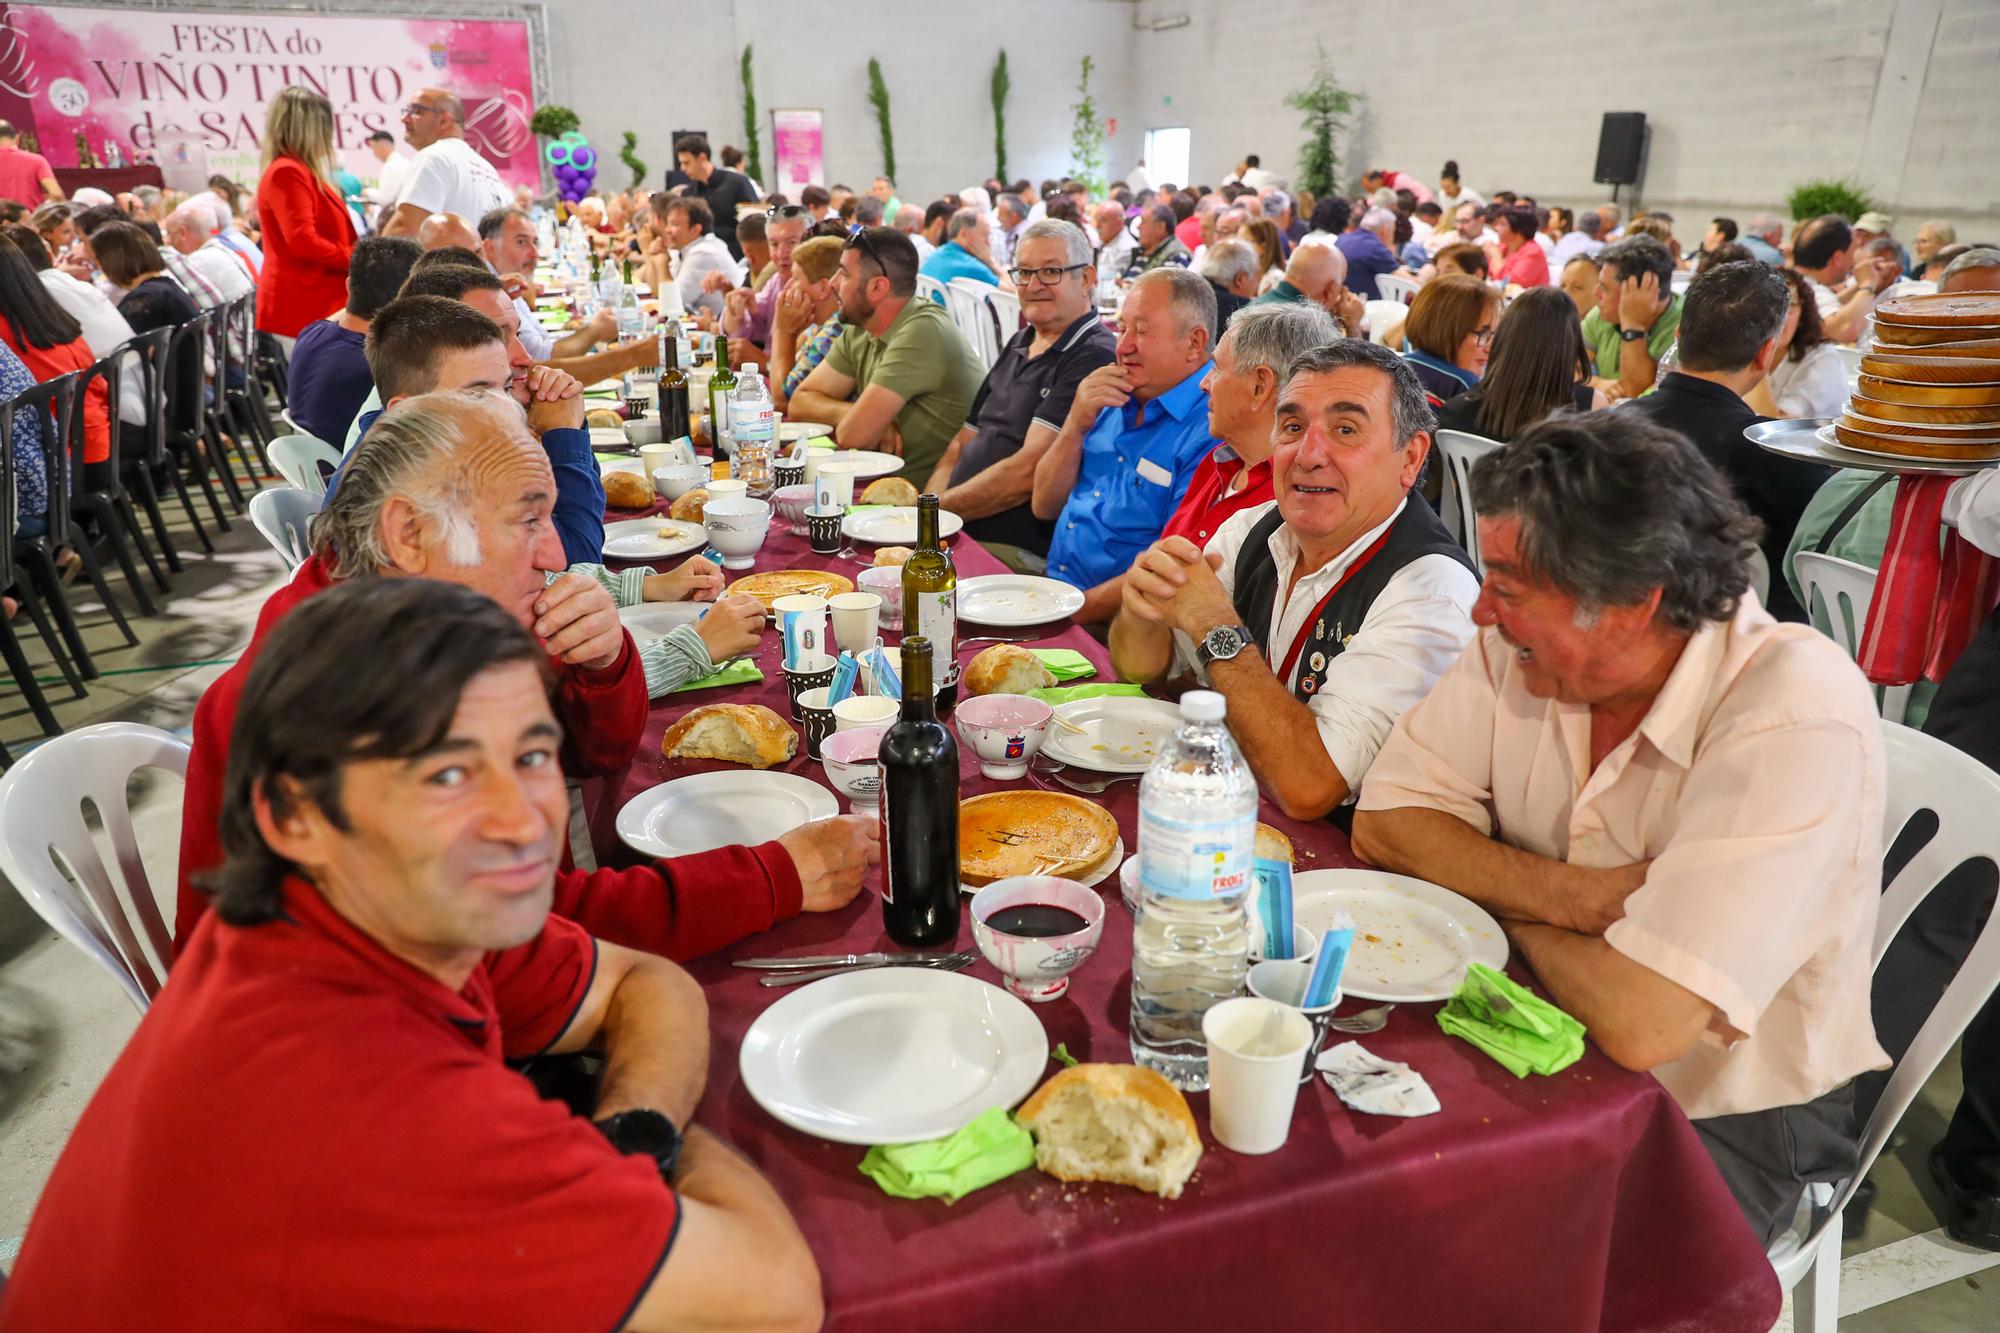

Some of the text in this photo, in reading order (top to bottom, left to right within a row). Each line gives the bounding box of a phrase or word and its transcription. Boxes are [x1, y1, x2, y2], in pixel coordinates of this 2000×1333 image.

[172, 24, 322, 55] FESTA do
[91, 52, 404, 103] VIÑO TINTO
[200, 103, 386, 150] SAÉS
